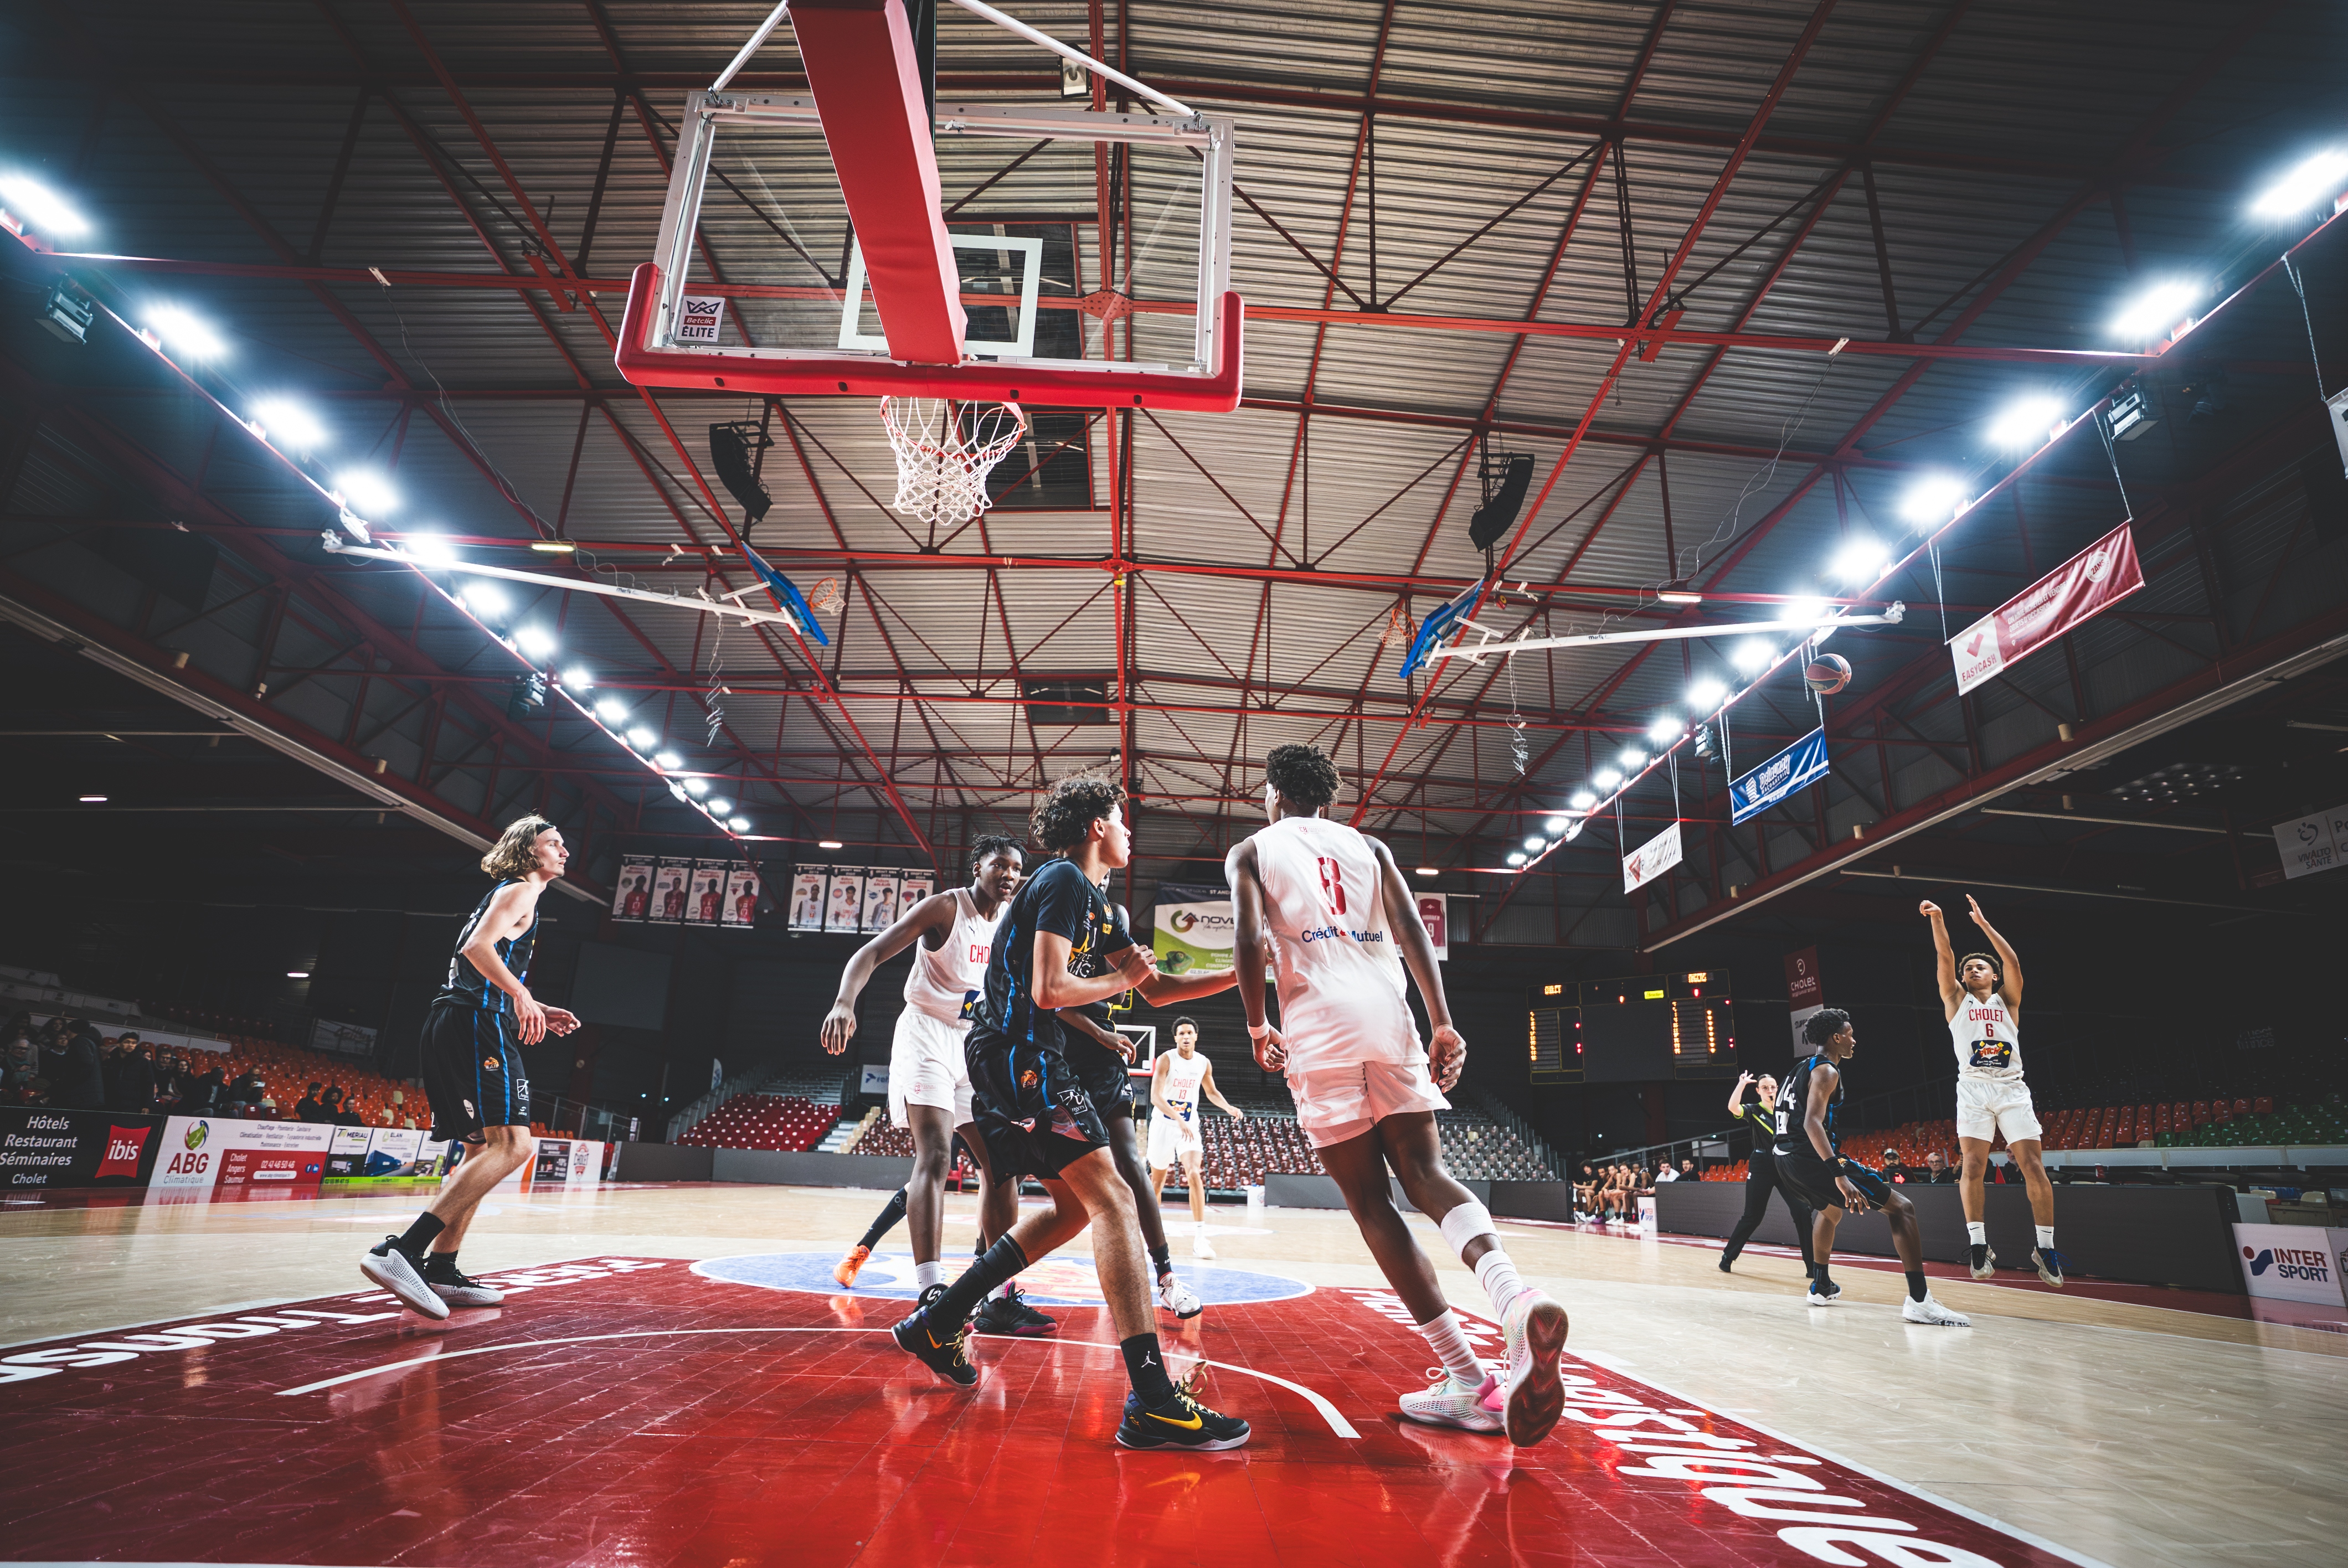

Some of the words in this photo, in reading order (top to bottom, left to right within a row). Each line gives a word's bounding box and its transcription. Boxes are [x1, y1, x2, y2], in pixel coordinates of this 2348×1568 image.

[681, 326, 715, 338] ÉLITE
[1961, 653, 1997, 682] EASYCASH
[2298, 848, 2331, 863] VIVALTO
[1302, 926, 1339, 942] Crédit
[1347, 931, 1383, 942] Mutuel
[970, 945, 990, 963] CHO
[1969, 1008, 2004, 1023] CHOLET
[1986, 1023, 1994, 1038] 6
[1173, 1078, 1196, 1088] CHOLET
[1178, 1089, 1187, 1100] 13
[27, 1116, 70, 1130] Hôtels
[4, 1134, 78, 1148] Restaurant
[108, 1139, 139, 1160] ibis
[0, 1152, 72, 1165] Séminaires
[167, 1153, 209, 1174] ABG
[230, 1153, 248, 1162] Cholet
[226, 1164, 246, 1174] Angers
[12, 1173, 48, 1184] Cholet
[163, 1175, 204, 1185] Climatique
[224, 1174, 245, 1184] Saumur
[2274, 1248, 2327, 1267] INTER
[2278, 1264, 2328, 1282] SPORT
